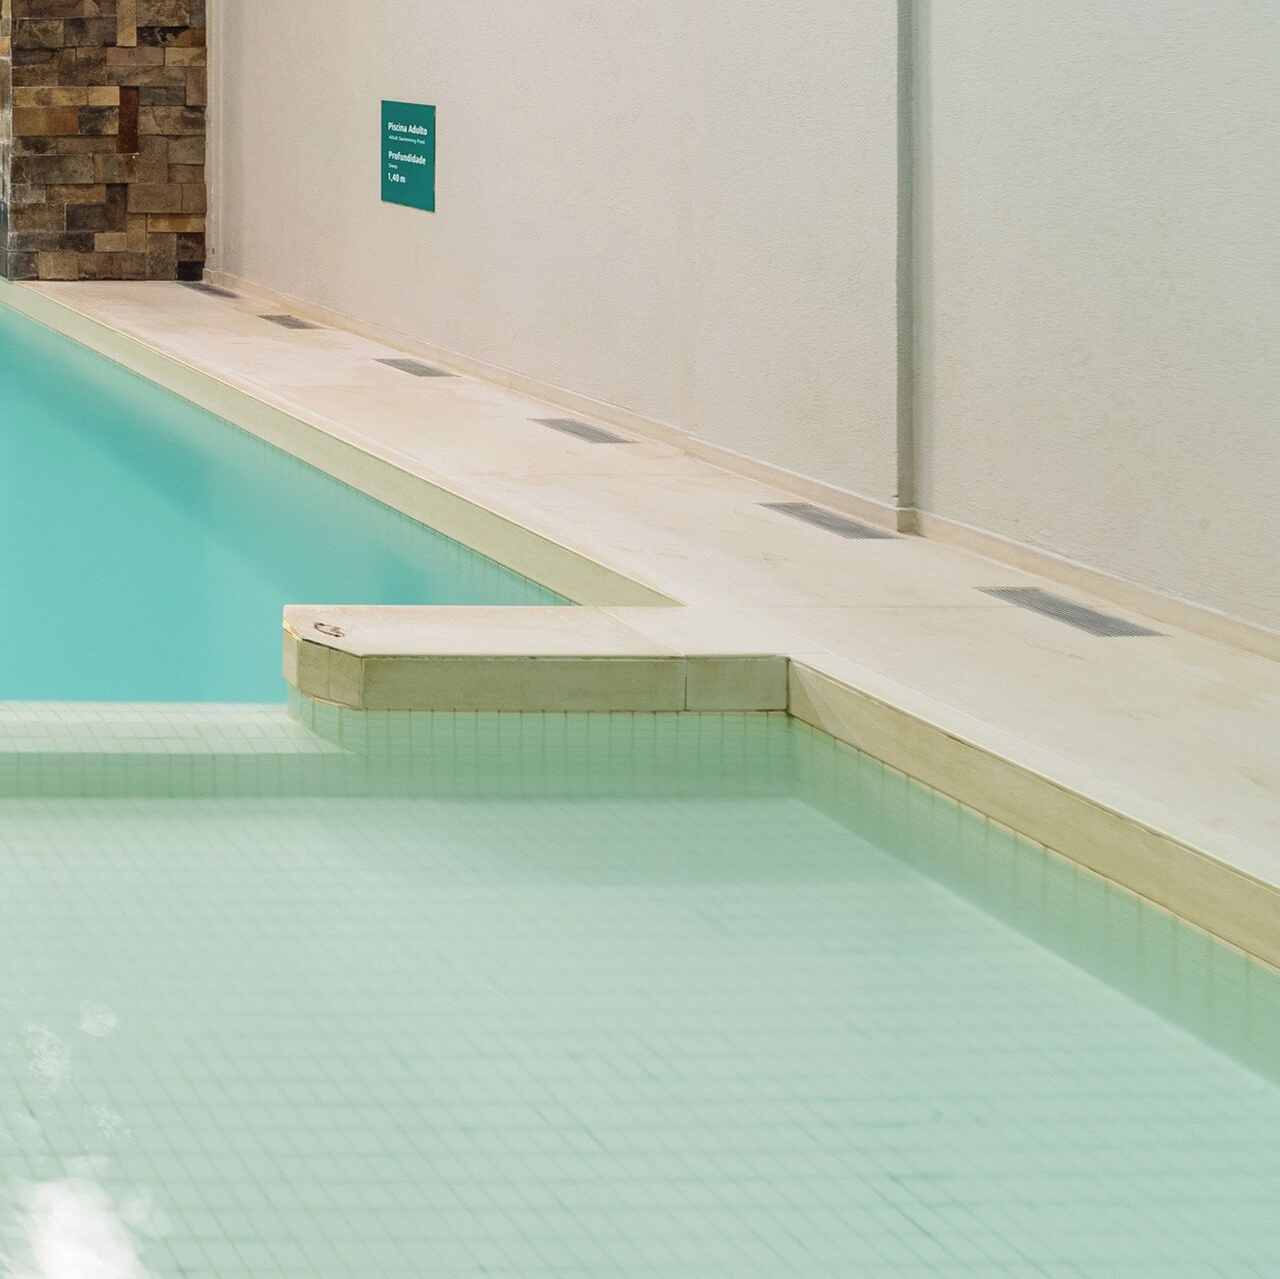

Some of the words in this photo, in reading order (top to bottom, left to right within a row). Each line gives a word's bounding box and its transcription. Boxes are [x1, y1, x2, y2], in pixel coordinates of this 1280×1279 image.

[387, 121, 408, 133] Piscina
[408, 124, 428, 136] Adulto
[387, 150, 426, 166] Profundidade
[387, 172, 400, 183] 1,40
